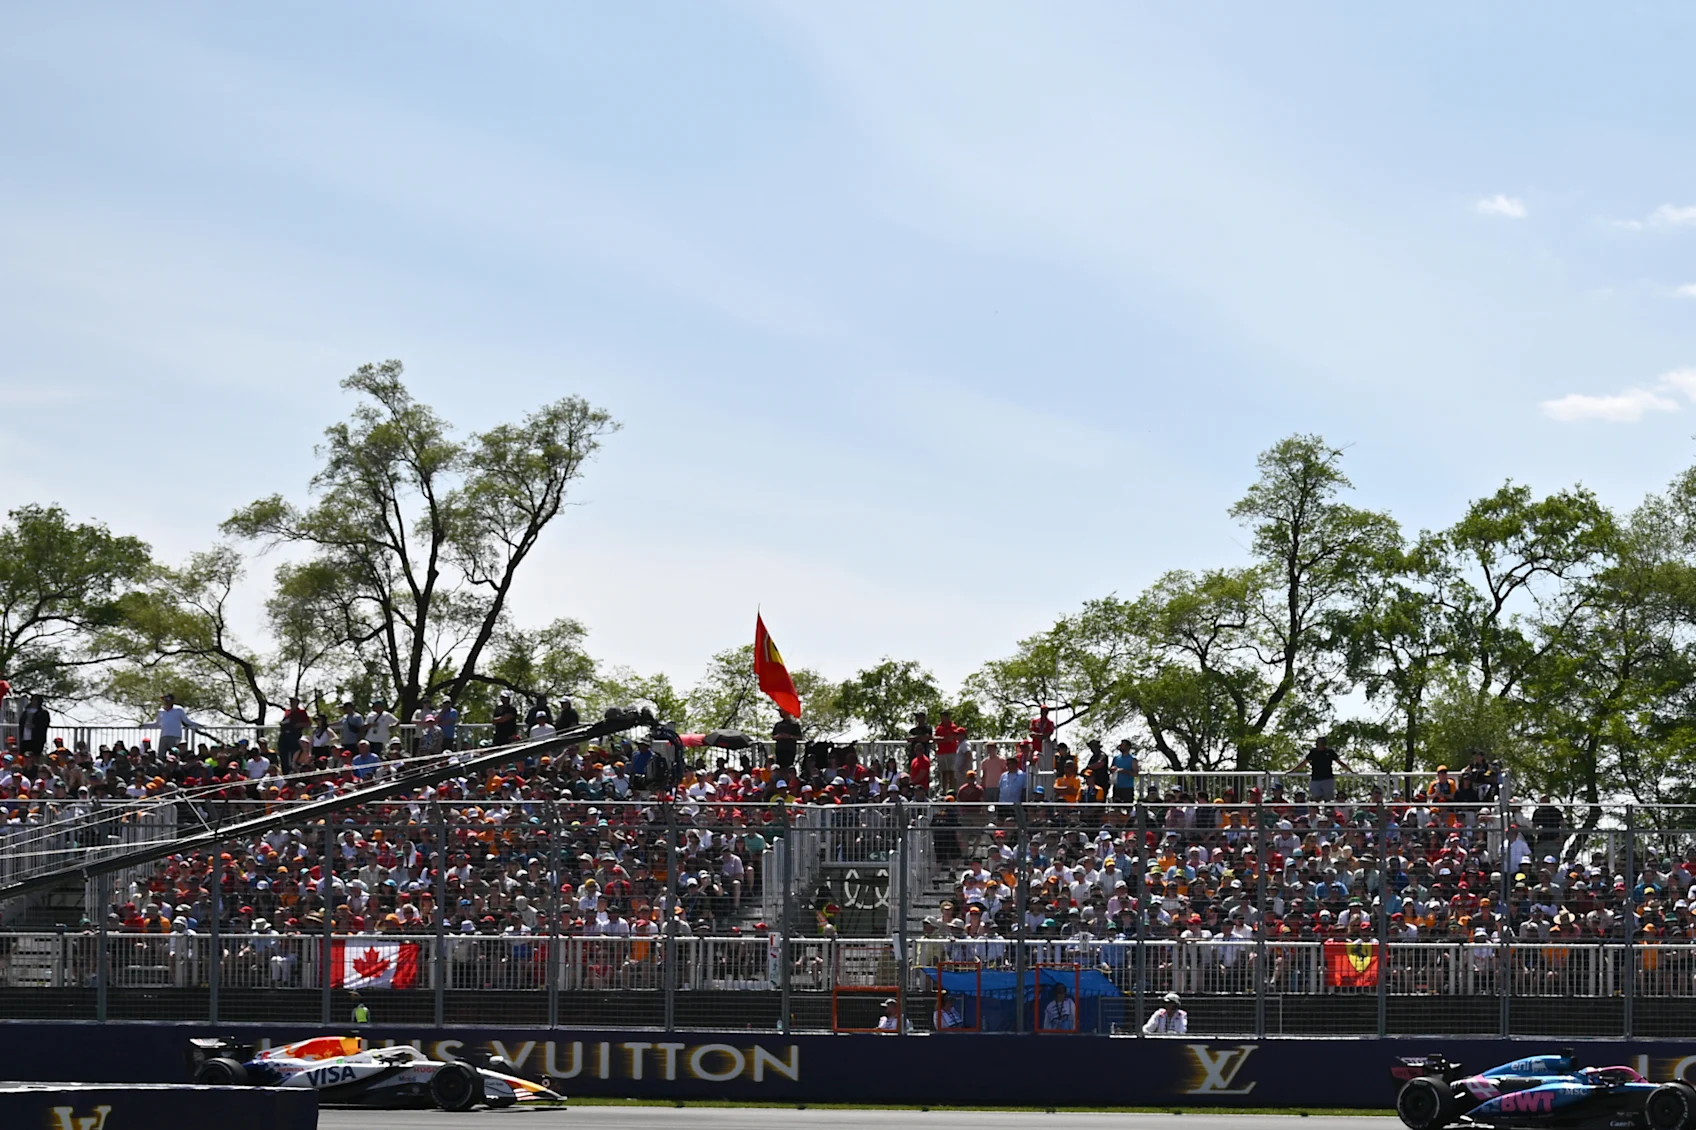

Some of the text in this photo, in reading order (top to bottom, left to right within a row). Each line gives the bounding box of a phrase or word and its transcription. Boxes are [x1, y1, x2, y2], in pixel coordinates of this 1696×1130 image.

[493, 1041, 799, 1082] VUITTON
[306, 1066, 356, 1087] VISA
[1501, 1092, 1555, 1113] BWT
